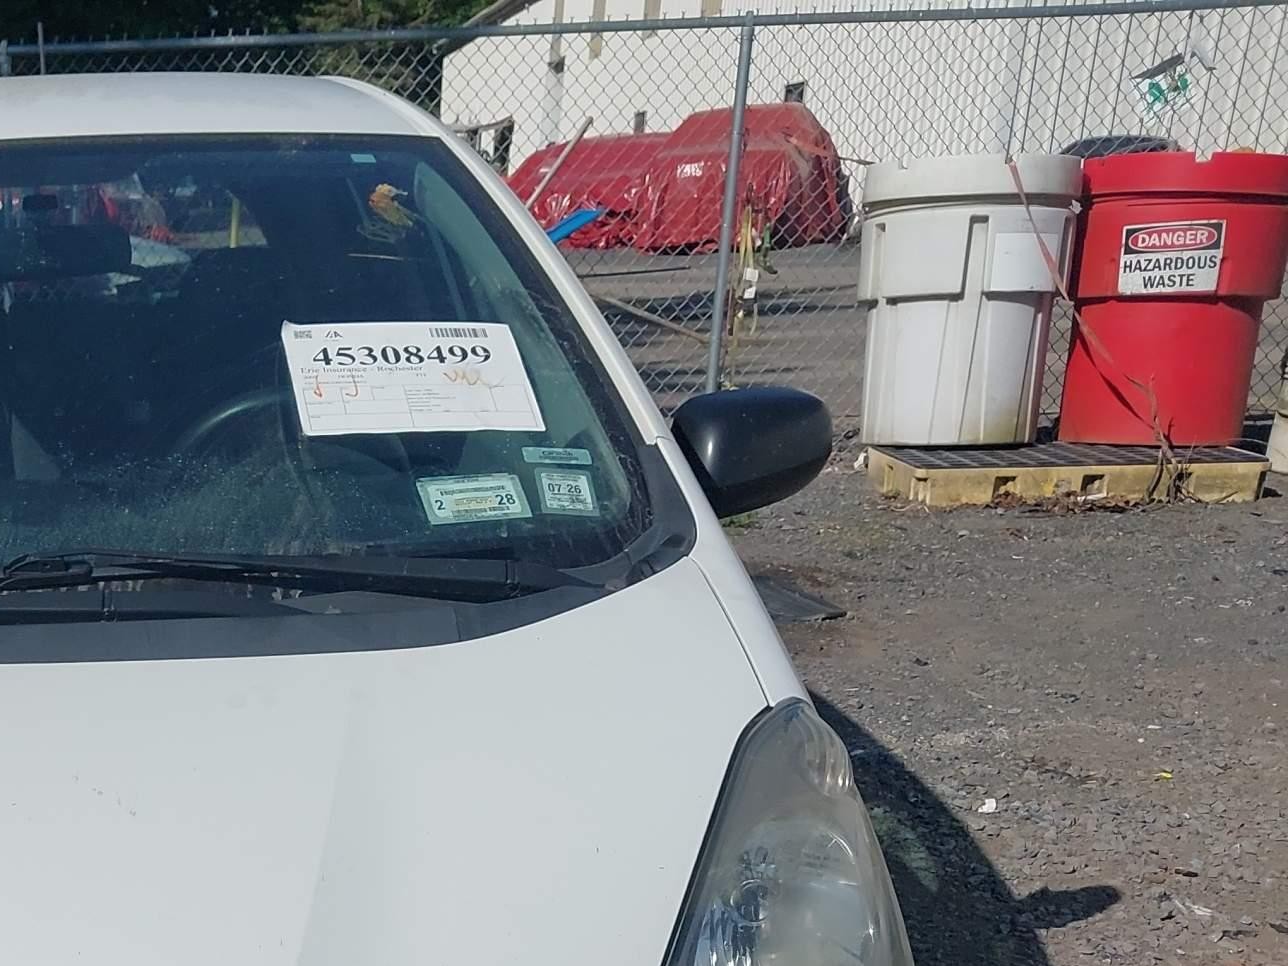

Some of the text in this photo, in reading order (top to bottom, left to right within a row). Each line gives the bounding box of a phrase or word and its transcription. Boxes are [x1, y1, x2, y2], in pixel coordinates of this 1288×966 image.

[1137, 230, 1209, 248] DANGER
[1123, 255, 1218, 273] HAZARDOUS
[1142, 273, 1196, 289] WASTE
[312, 344, 492, 366] 45308499
[434, 499, 446, 510] 2
[495, 493, 516, 506] 28
